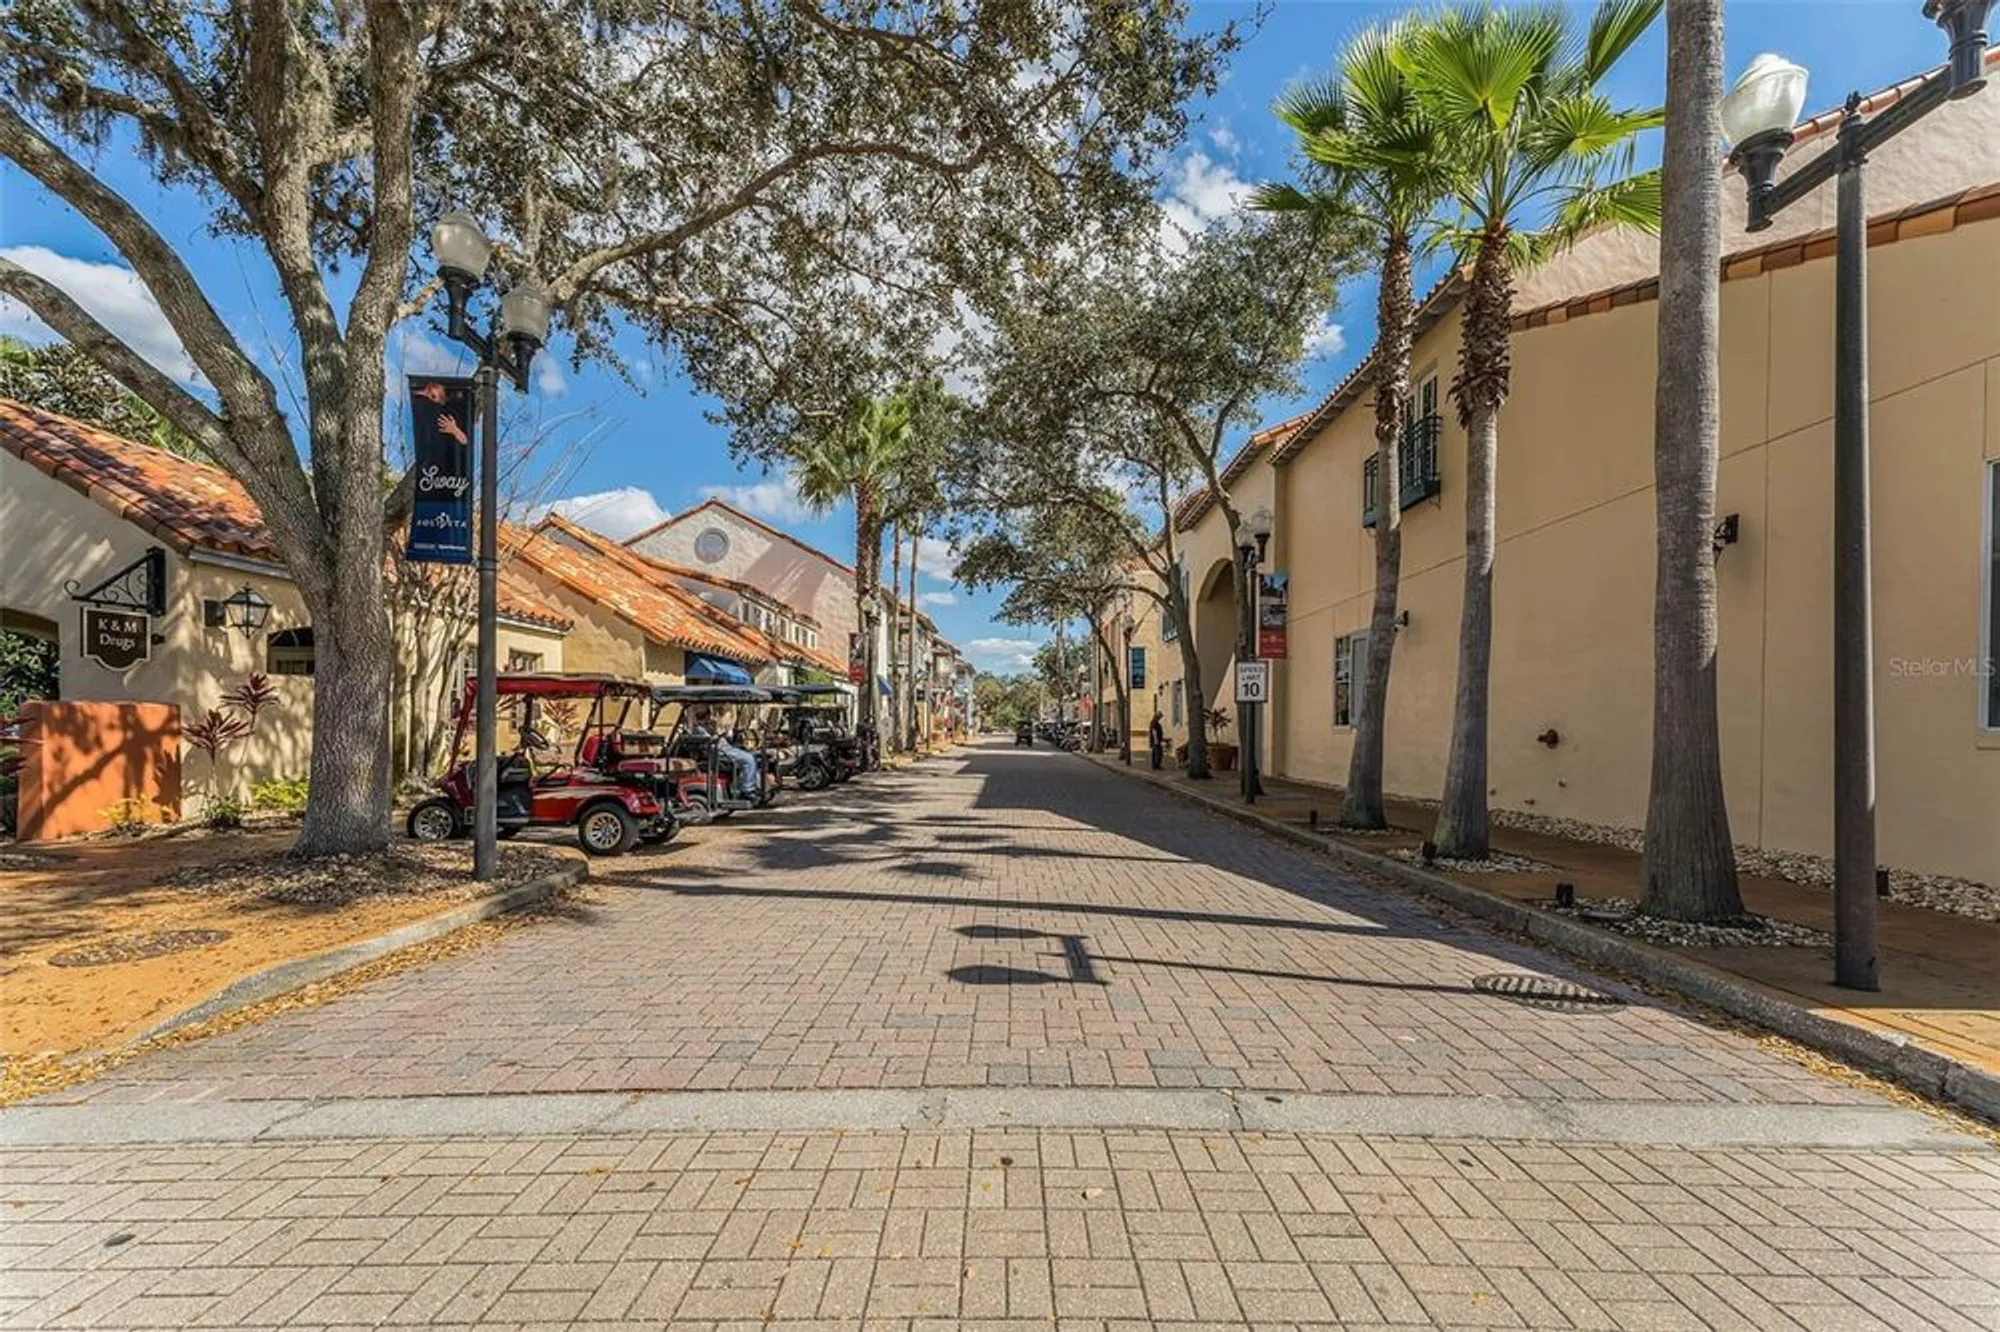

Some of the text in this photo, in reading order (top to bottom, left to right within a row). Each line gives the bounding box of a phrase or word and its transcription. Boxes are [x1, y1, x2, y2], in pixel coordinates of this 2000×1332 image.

[419, 465, 470, 497] Sway
[98, 618, 137, 633] K & M
[100, 633, 136, 651] Drugs
[1242, 681, 1260, 697] 10
